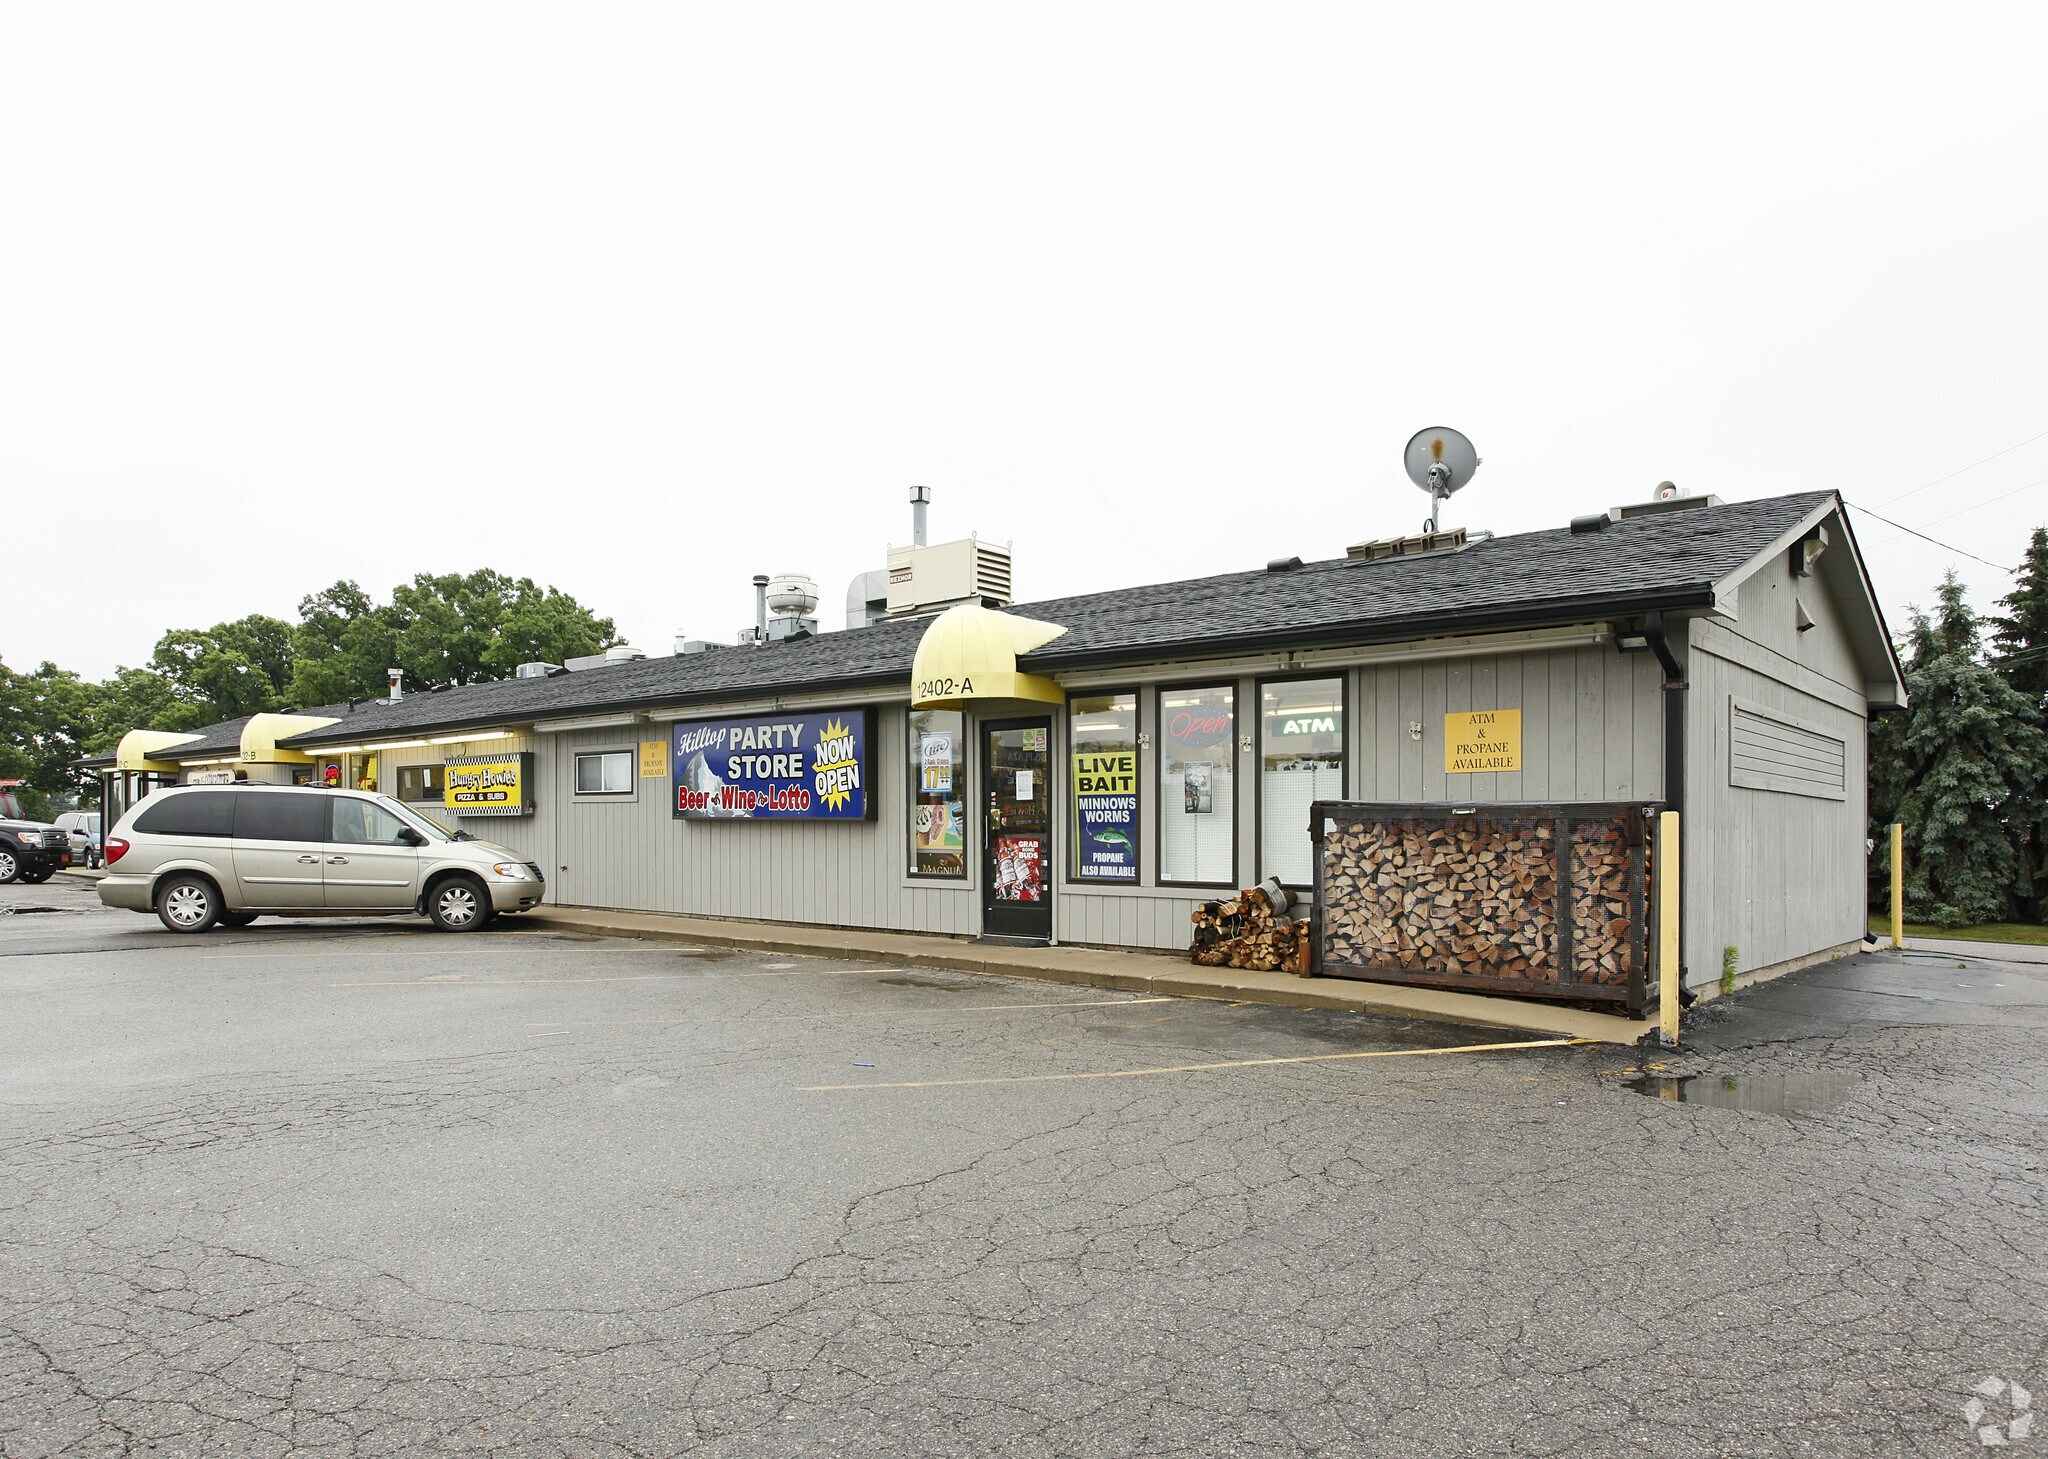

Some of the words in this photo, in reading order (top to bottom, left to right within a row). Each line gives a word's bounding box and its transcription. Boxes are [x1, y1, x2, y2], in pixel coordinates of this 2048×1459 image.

[889, 573, 912, 584] REZNOR
[917, 677, 974, 699] 12402-A
[1170, 712, 1228, 740] Open
[1282, 717, 1335, 735] ATM
[1469, 713, 1495, 725] ATM
[677, 726, 727, 757] Hilltop
[729, 723, 805, 751] PARTY
[1477, 728, 1486, 739] &
[815, 735, 855, 767] NOW
[1456, 742, 1509, 755] PROPANE
[728, 753, 804, 779] STORE
[1078, 756, 1134, 775] LIVE
[1453, 757, 1513, 769] AVAILABLE
[449, 769, 481, 791] Hungry
[482, 768, 517, 790] Howie's
[815, 764, 860, 796] OPEN
[1078, 775, 1133, 793] BAIT
[457, 793, 476, 802] PIZZA
[478, 793, 484, 801] &
[487, 792, 505, 801] SUBS
[678, 785, 709, 810] Beer
[721, 784, 756, 811] Wine
[768, 783, 811, 811] Lotto
[1079, 796, 1136, 811] MINNOWS
[1085, 809, 1131, 824] WORMS
[1018, 840, 1039, 848] GRAB
[1092, 852, 1125, 864] PROPANE
[1081, 865, 1099, 876] ALSO
[1099, 864, 1136, 877] AVAILABLE
